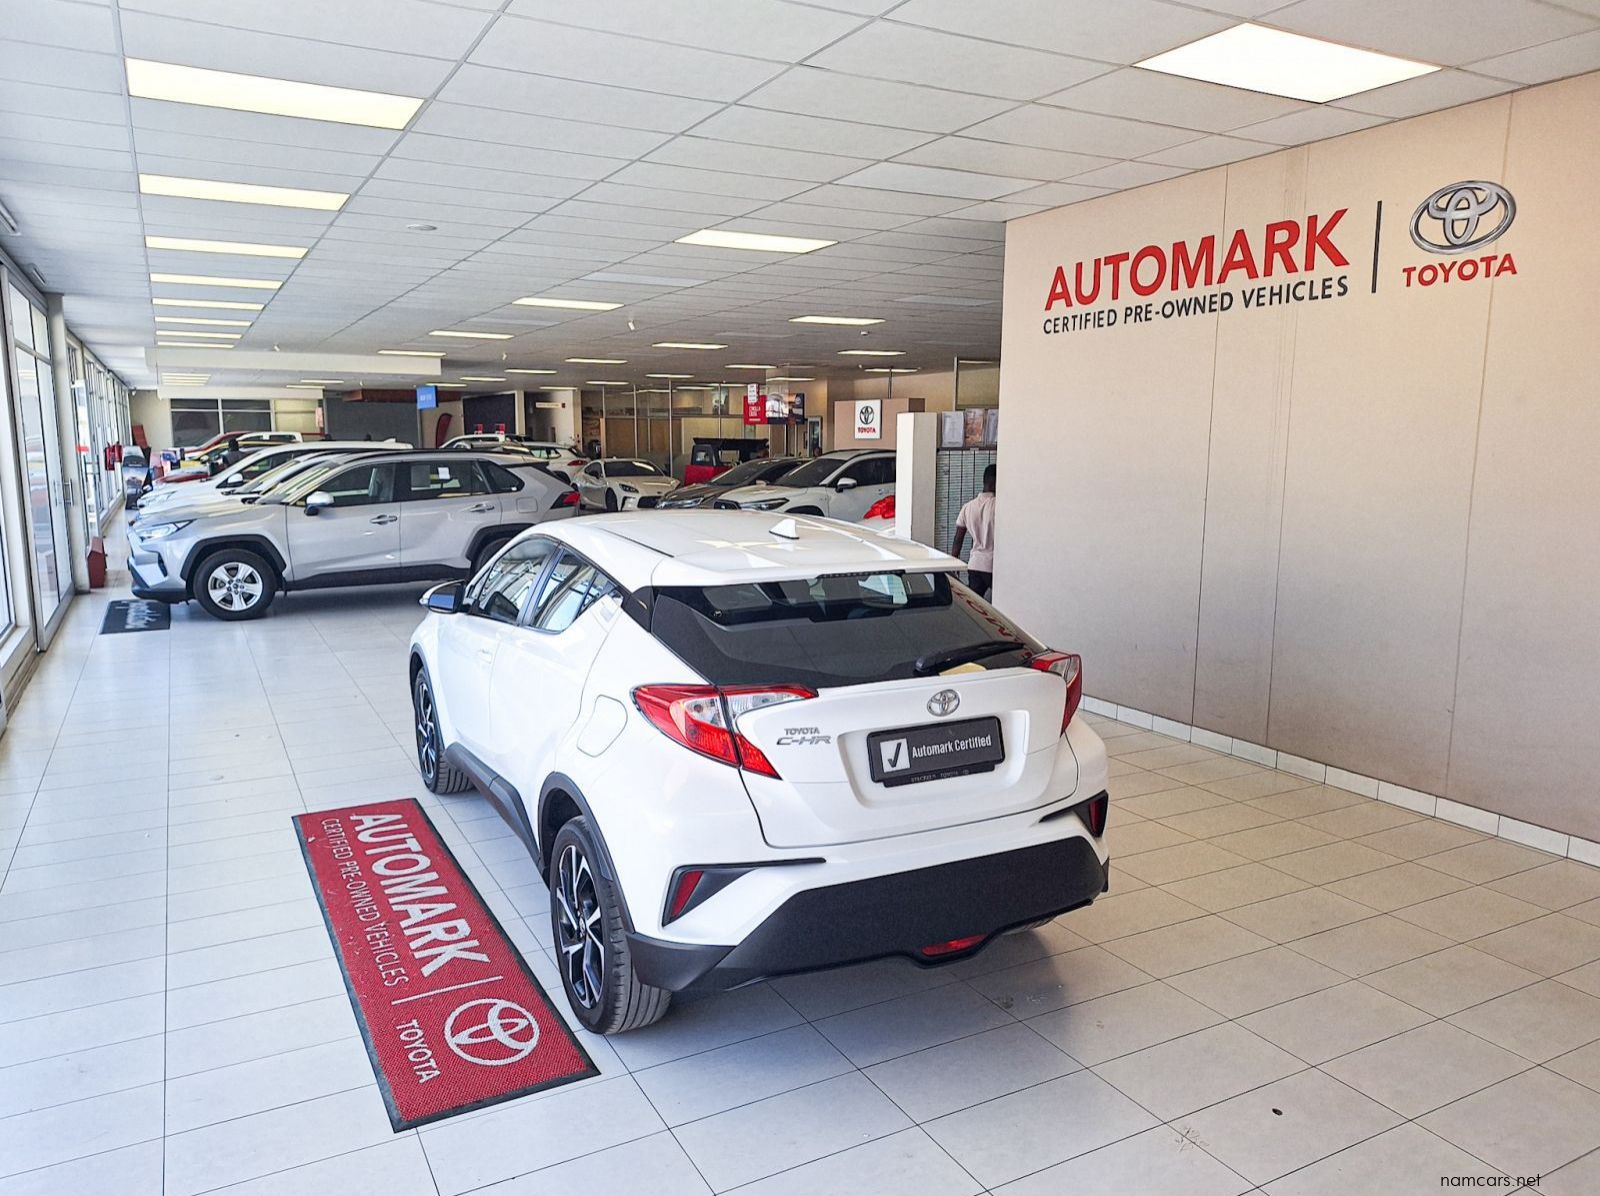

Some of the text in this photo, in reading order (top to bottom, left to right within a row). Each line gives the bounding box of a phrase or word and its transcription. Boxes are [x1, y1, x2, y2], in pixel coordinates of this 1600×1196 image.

[1045, 208, 1350, 311] AUTOMARK
[1402, 253, 1518, 288] TOYOTA
[1043, 275, 1349, 335] CERTIFIED PRE-OWNED VEHICLES
[776, 735, 832, 746] C-HR
[784, 727, 820, 736] TOYOTA
[912, 734, 992, 758] Automark Certified
[320, 818, 409, 987] CERTIFIED PRE-OWNED VEHICLES
[349, 813, 491, 978] AUTOMARK
[395, 1019, 444, 1085] TOYOTA
